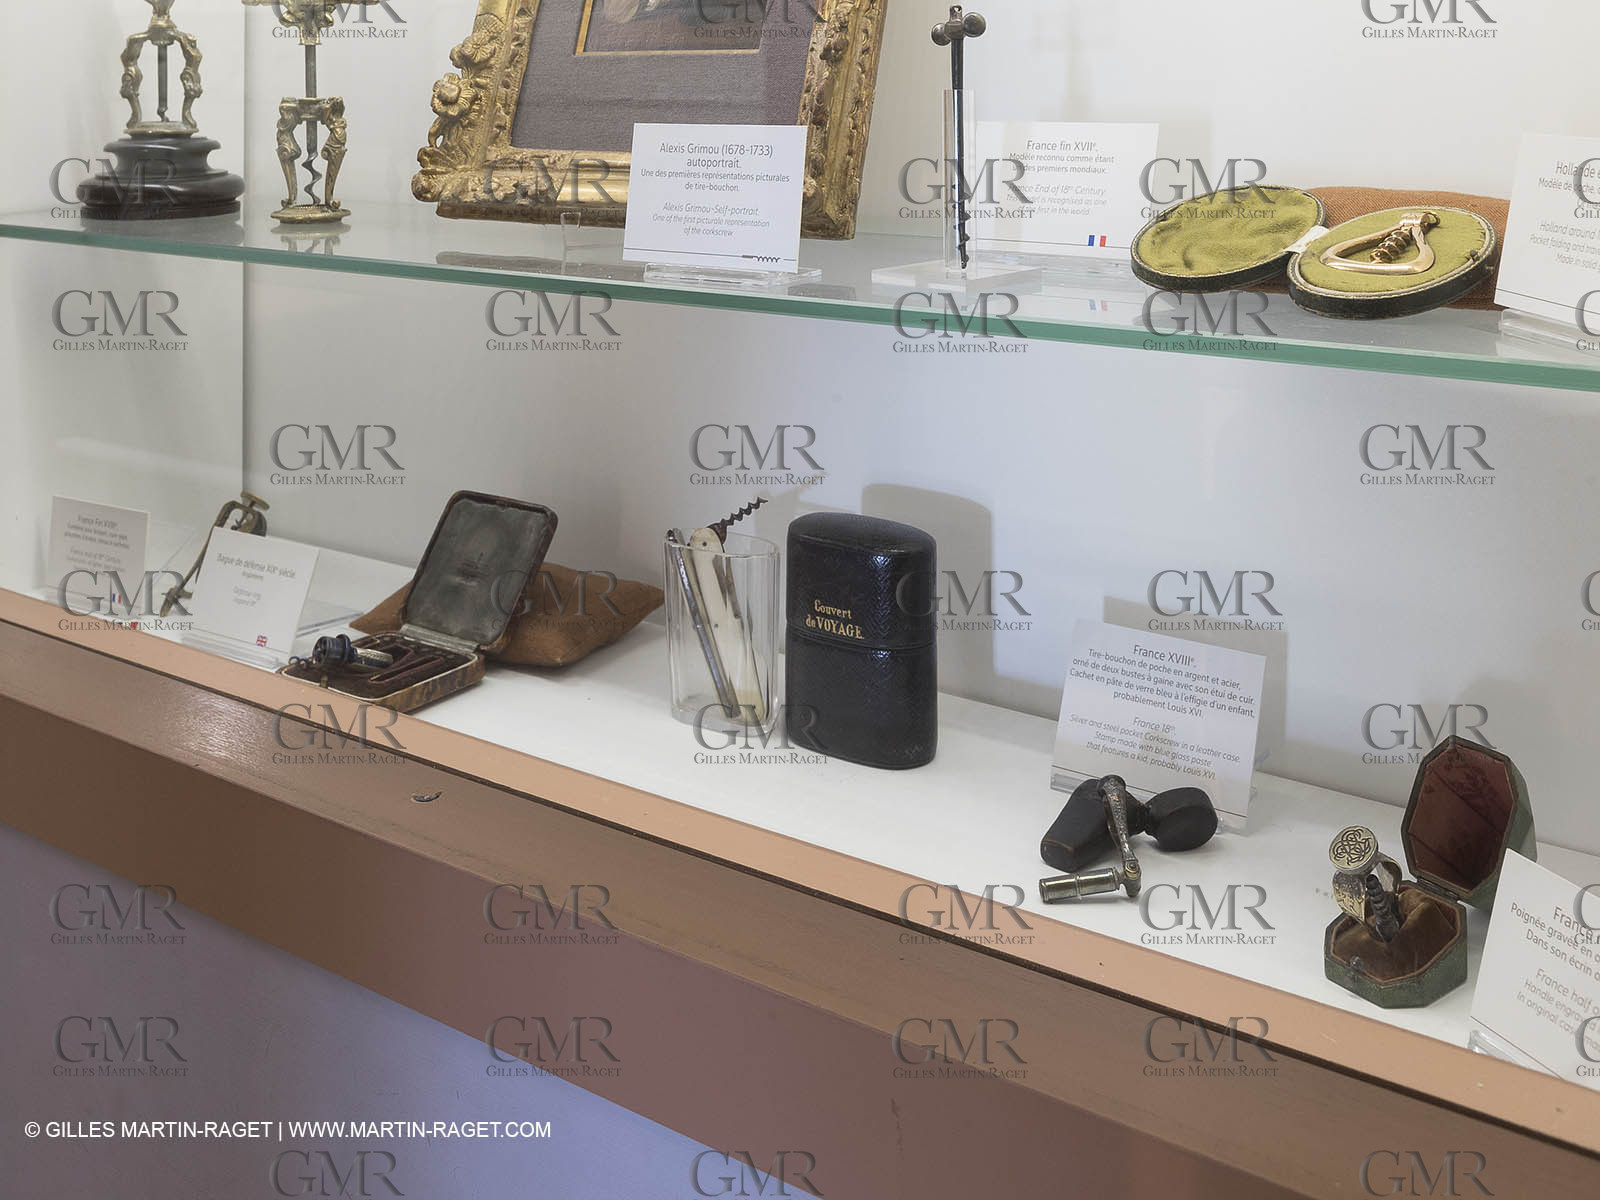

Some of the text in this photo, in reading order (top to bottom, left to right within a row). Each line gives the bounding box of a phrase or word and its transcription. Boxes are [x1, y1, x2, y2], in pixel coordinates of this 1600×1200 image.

[660, 143, 773, 158] Alexis Grimou (1678-1733)
[1027, 140, 1057, 151] France
[1060, 140, 1071, 151] fin
[686, 158, 741, 169] autoportrait.
[1067, 155, 1093, 163] comme
[1095, 154, 1114, 163] étant
[655, 169, 667, 178] des
[756, 174, 790, 182] picturales
[685, 182, 694, 190] de
[663, 202, 683, 211] Alexis
[814, 600, 852, 619] Couvert
[1133, 645, 1165, 661] France
[1088, 648, 1241, 691] Tire-bouchon de poche en argent et acier,
[1070, 668, 1097, 682] Cachet
[1099, 674, 1105, 683] en
[1106, 676, 1123, 689] pâte
[1124, 679, 1134, 690] de
[1136, 683, 1154, 695] verre
[1155, 685, 1172, 699] bleu
[1174, 691, 1179, 700] à
[1073, 656, 1255, 705] orné de deux bustes à gaine avec son étui de cuir.
[1113, 690, 1166, 710] probablement
[1167, 700, 1187, 714] Louis
[1120, 725, 1143, 740] pocket
[1132, 716, 1160, 732] France
[1095, 731, 1116, 746] Stamp
[1117, 736, 1137, 749] made
[1151, 756, 1182, 773] probably
[1510, 902, 1546, 932] Poignée
[1580, 945, 1593, 958] en
[1554, 906, 1594, 938] France
[1526, 928, 1549, 948] Dans
[1550, 944, 1567, 962] son
[1569, 953, 1592, 977] écrin
[1536, 968, 1569, 997] France
